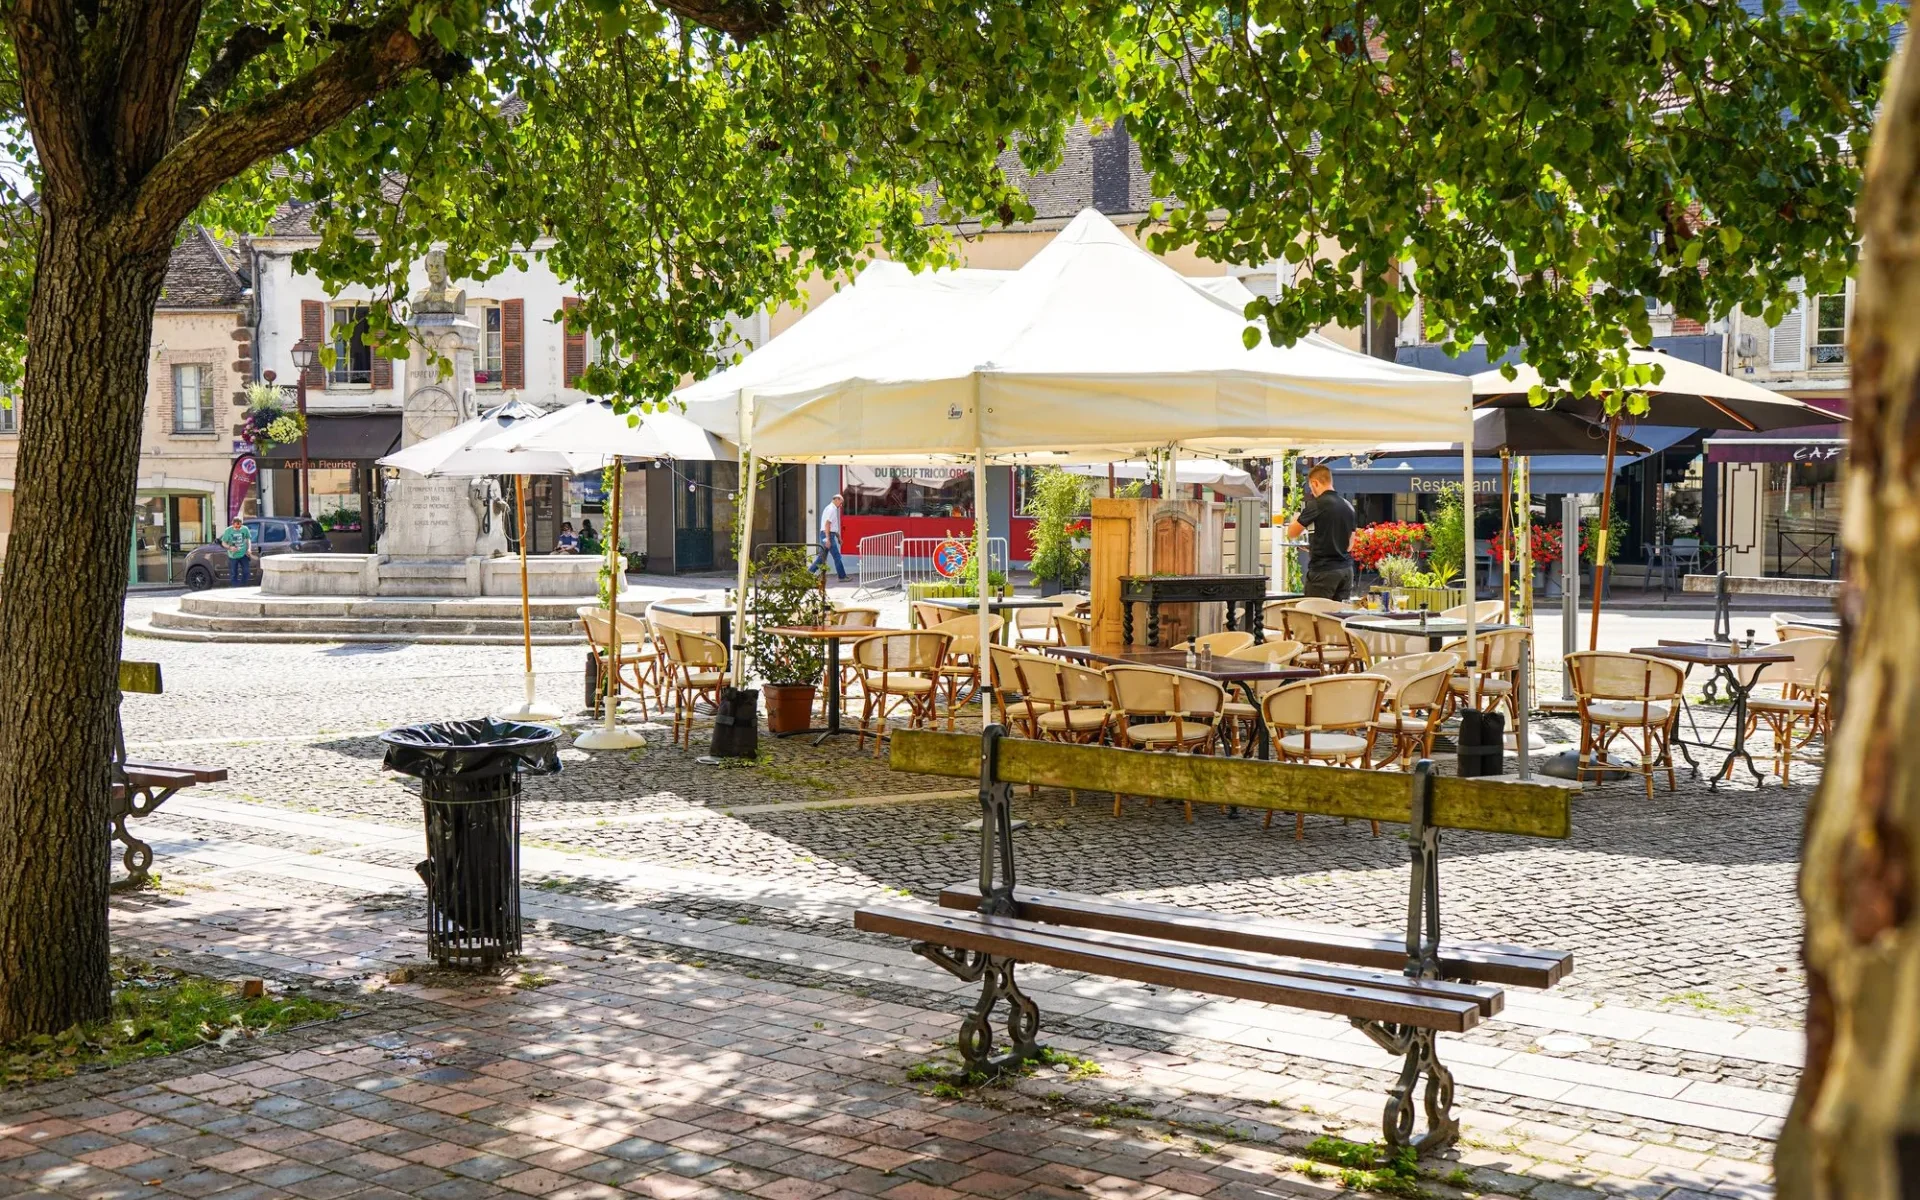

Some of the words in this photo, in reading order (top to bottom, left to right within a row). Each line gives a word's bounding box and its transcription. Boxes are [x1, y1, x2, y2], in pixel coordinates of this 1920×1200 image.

[319, 460, 357, 469] Fleuriste
[875, 468, 888, 478] DU
[890, 468, 918, 478] BOEUF
